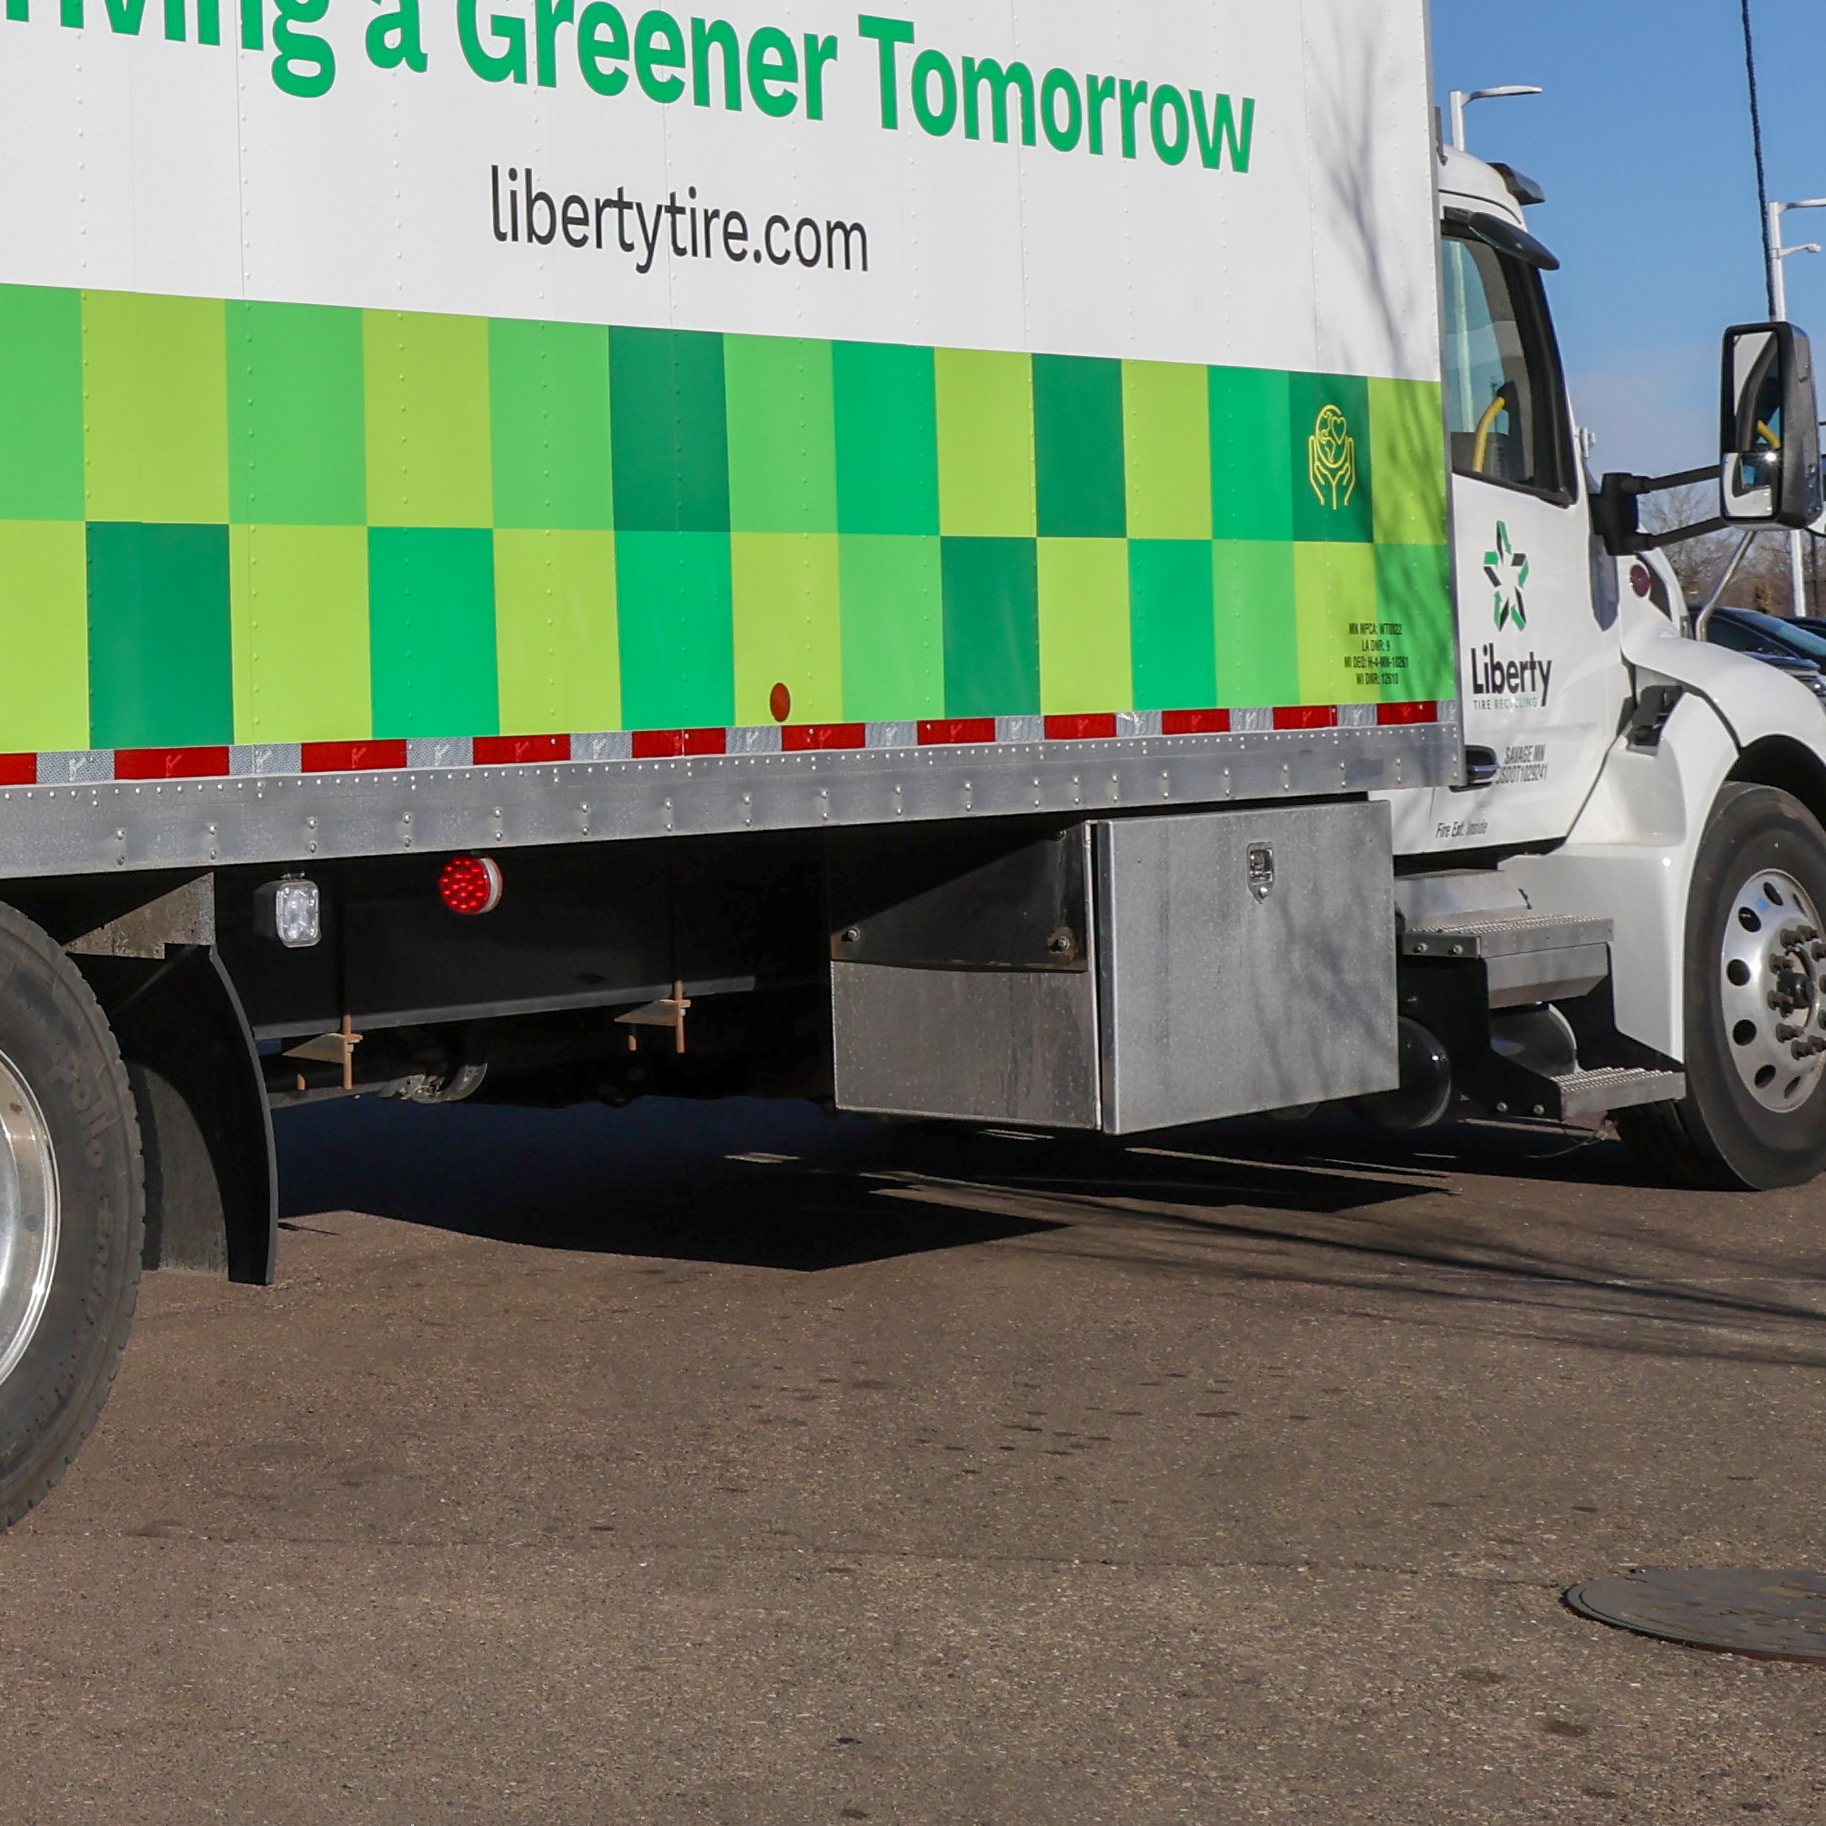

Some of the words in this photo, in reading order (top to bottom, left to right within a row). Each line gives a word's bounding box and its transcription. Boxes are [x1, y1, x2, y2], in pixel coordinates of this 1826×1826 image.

[857, 13, 1256, 175] Tomorrow
[490, 163, 869, 275] libertytire.com
[1470, 642, 1552, 707] Liberty
[1473, 699, 1491, 710] TIRE
[1435, 822, 1450, 838] Fire
